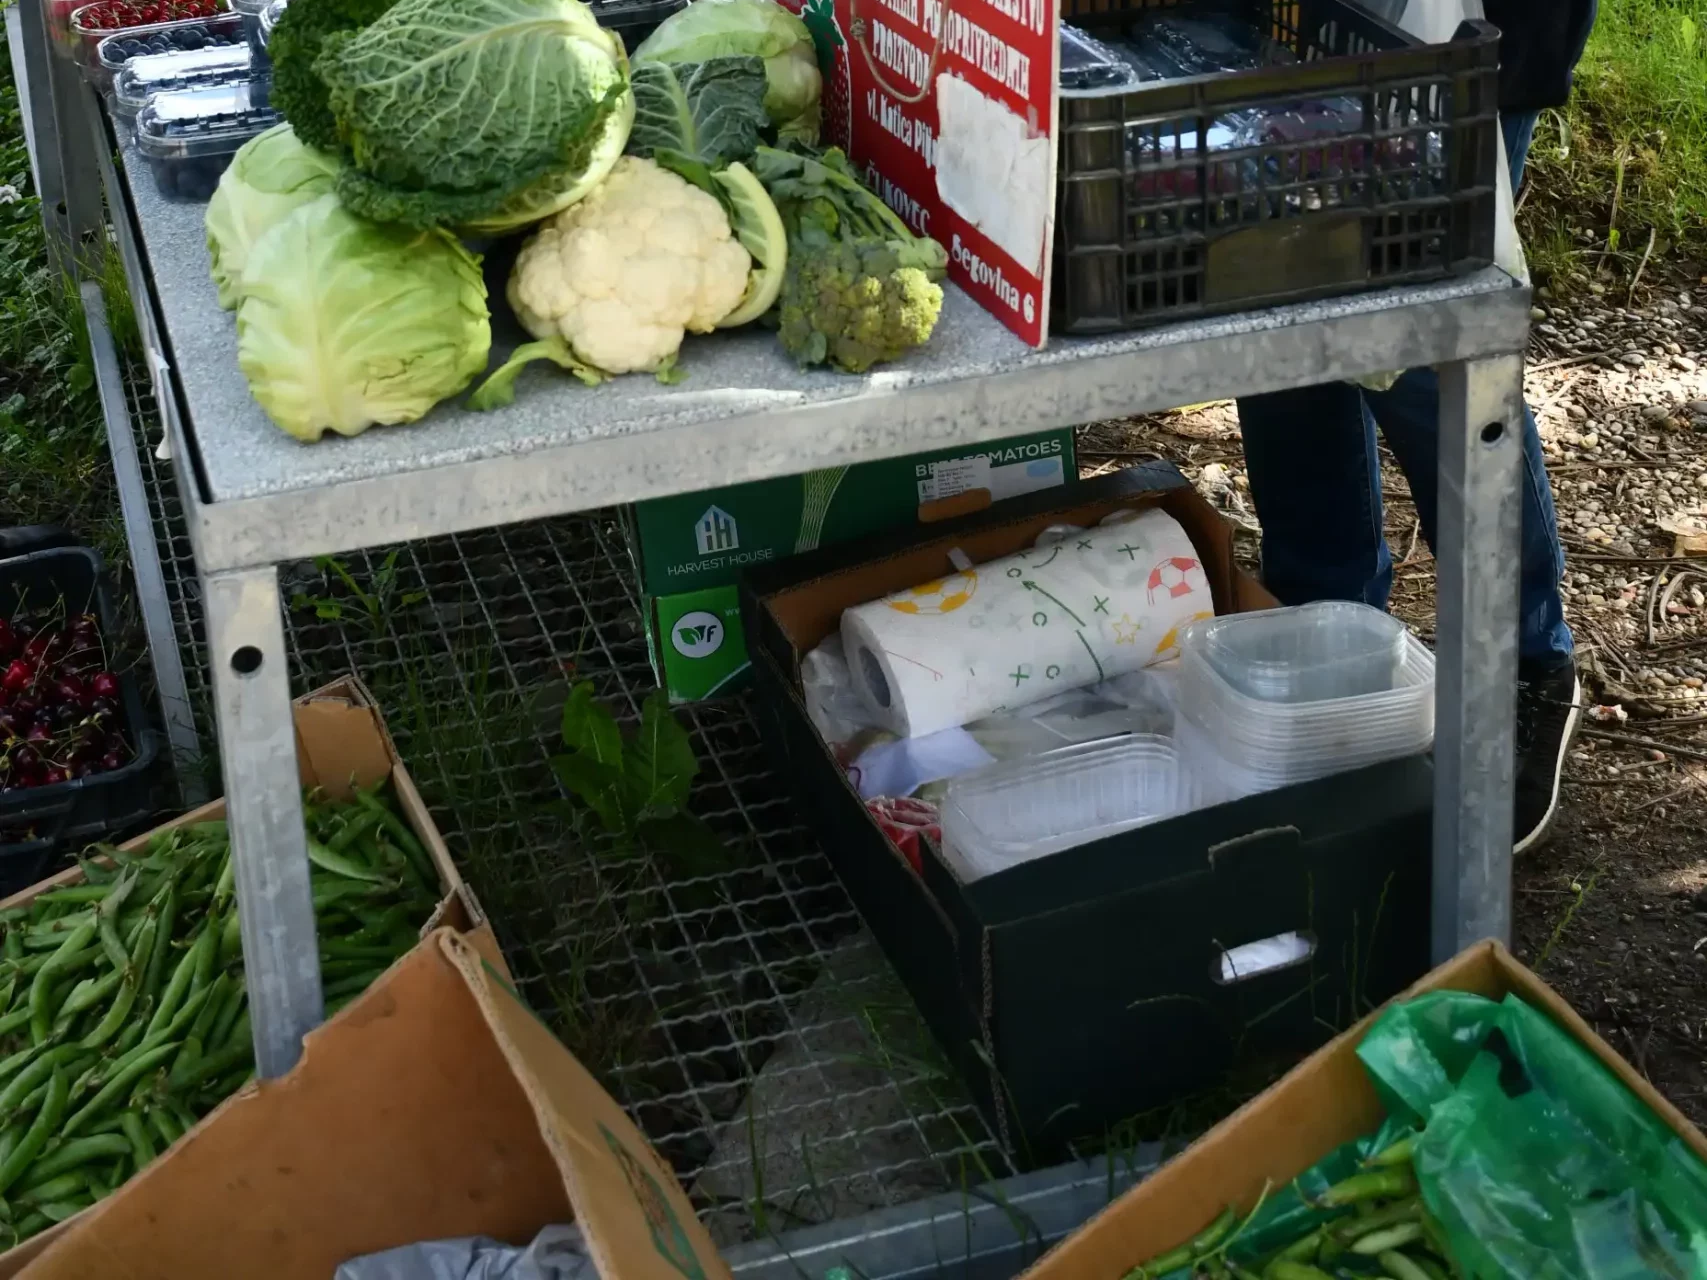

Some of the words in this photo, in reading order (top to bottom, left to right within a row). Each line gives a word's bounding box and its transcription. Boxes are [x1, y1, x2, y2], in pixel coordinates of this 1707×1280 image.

[965, 439, 1062, 466] MATOES
[667, 557, 726, 576] HARVEST
[729, 548, 774, 566] HOUSE
